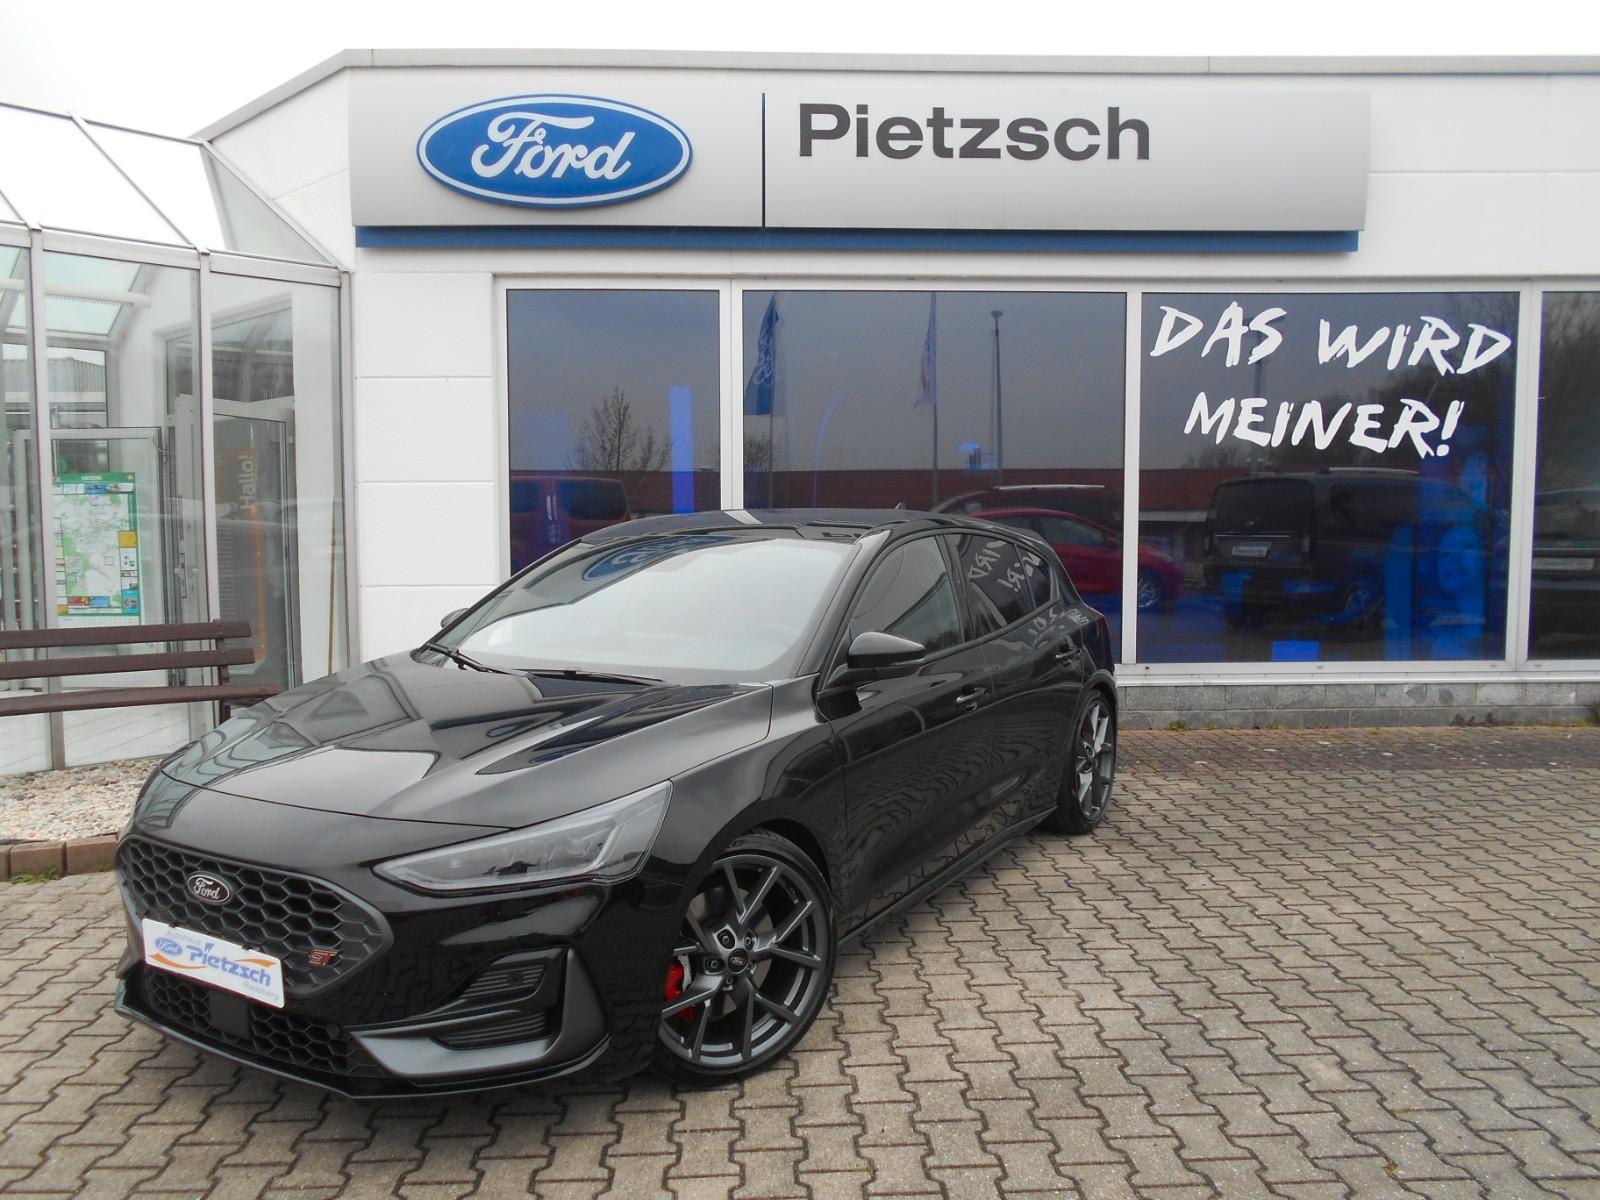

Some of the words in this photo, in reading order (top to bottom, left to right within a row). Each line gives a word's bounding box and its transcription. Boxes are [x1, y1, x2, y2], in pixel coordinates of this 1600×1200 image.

[471, 111, 635, 180] Ford
[799, 103, 1150, 161] Pietzsch
[1149, 301, 1288, 368] DAS
[1317, 315, 1512, 377] WIRD
[1183, 391, 1465, 460] MEINER!
[193, 877, 220, 900] Ford
[187, 942, 271, 986] Pietzsch
[310, 949, 337, 966] ST
